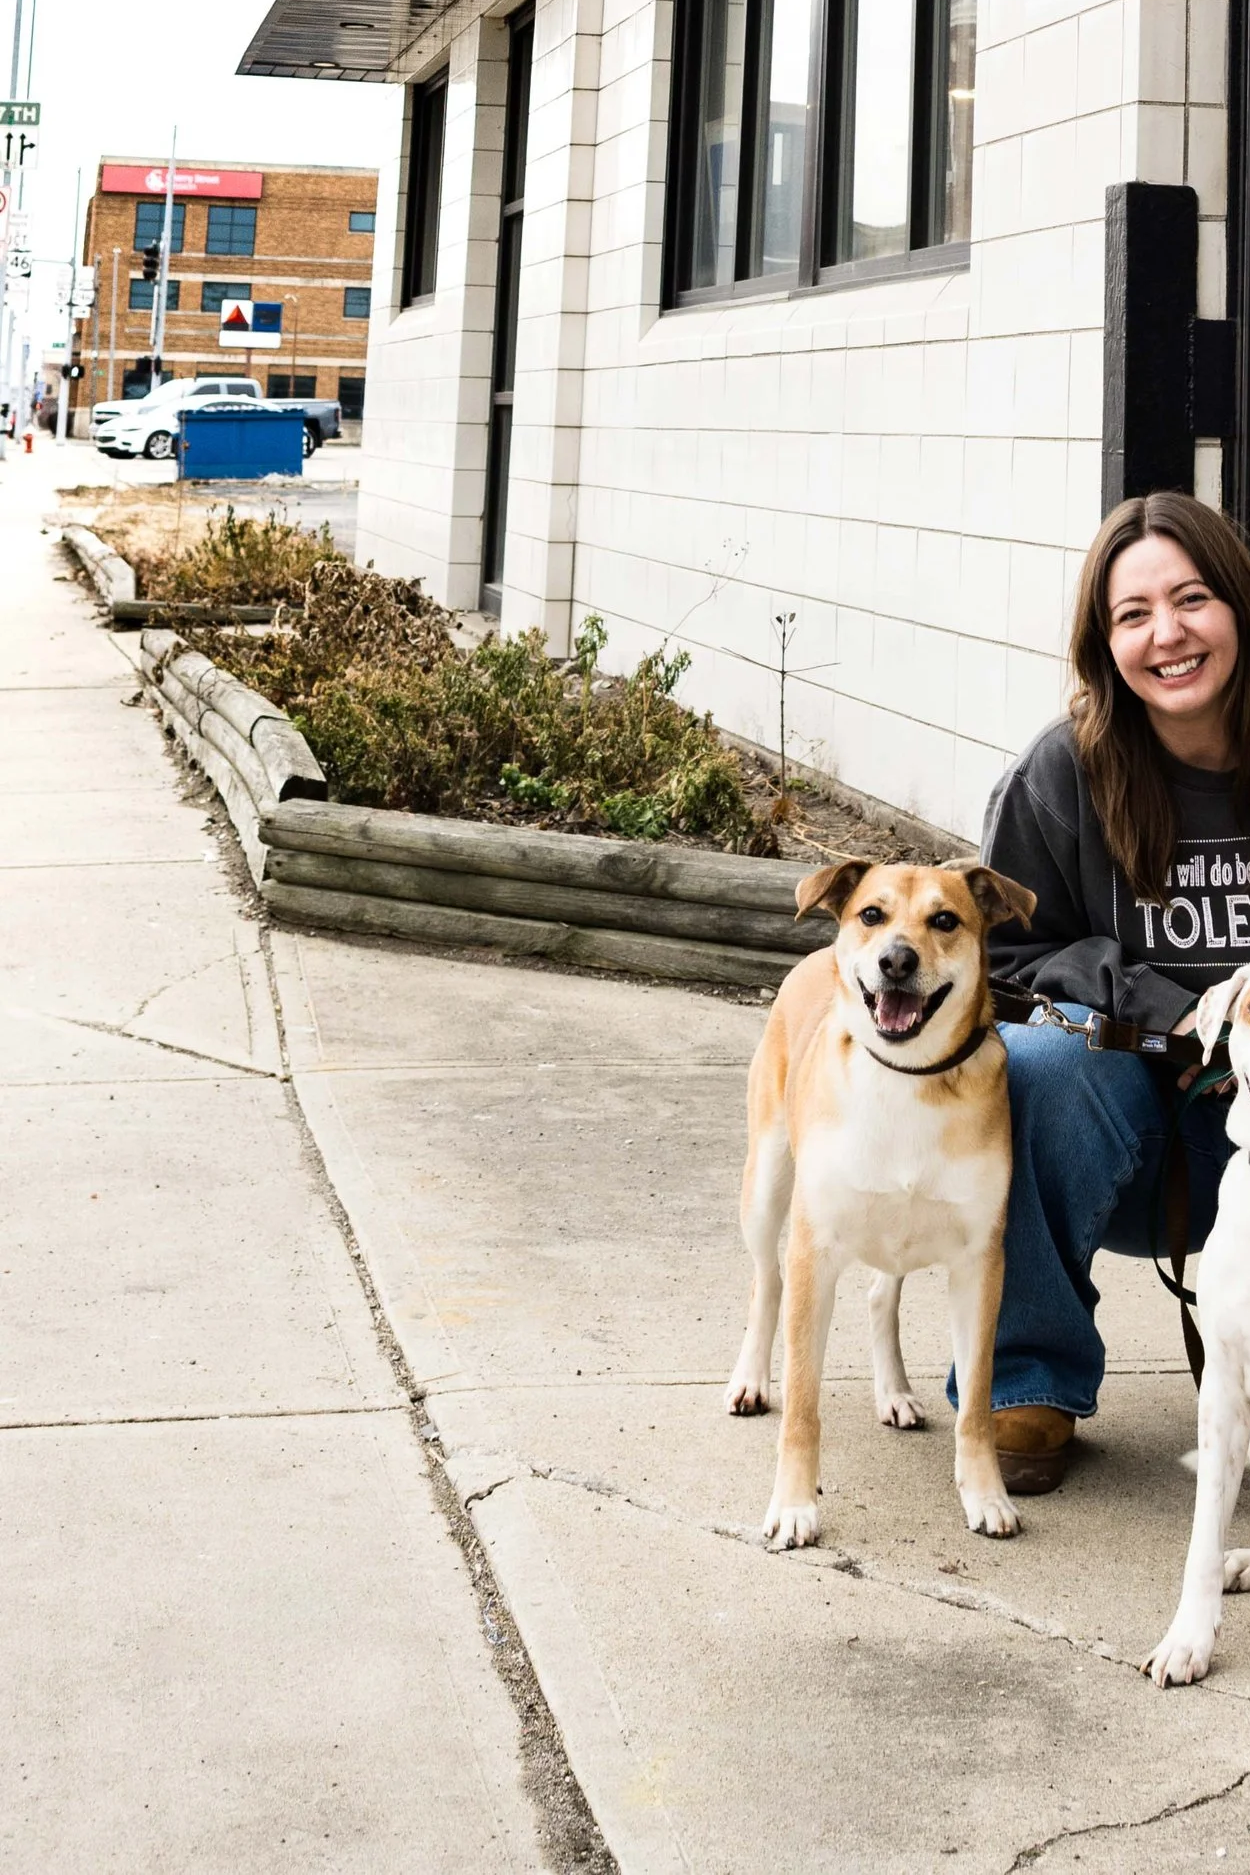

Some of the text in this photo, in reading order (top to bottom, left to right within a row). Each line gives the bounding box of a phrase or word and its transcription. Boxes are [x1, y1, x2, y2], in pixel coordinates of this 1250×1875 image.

[6, 256, 29, 269] 46
[1176, 855, 1205, 887] will
[1210, 854, 1233, 887] do
